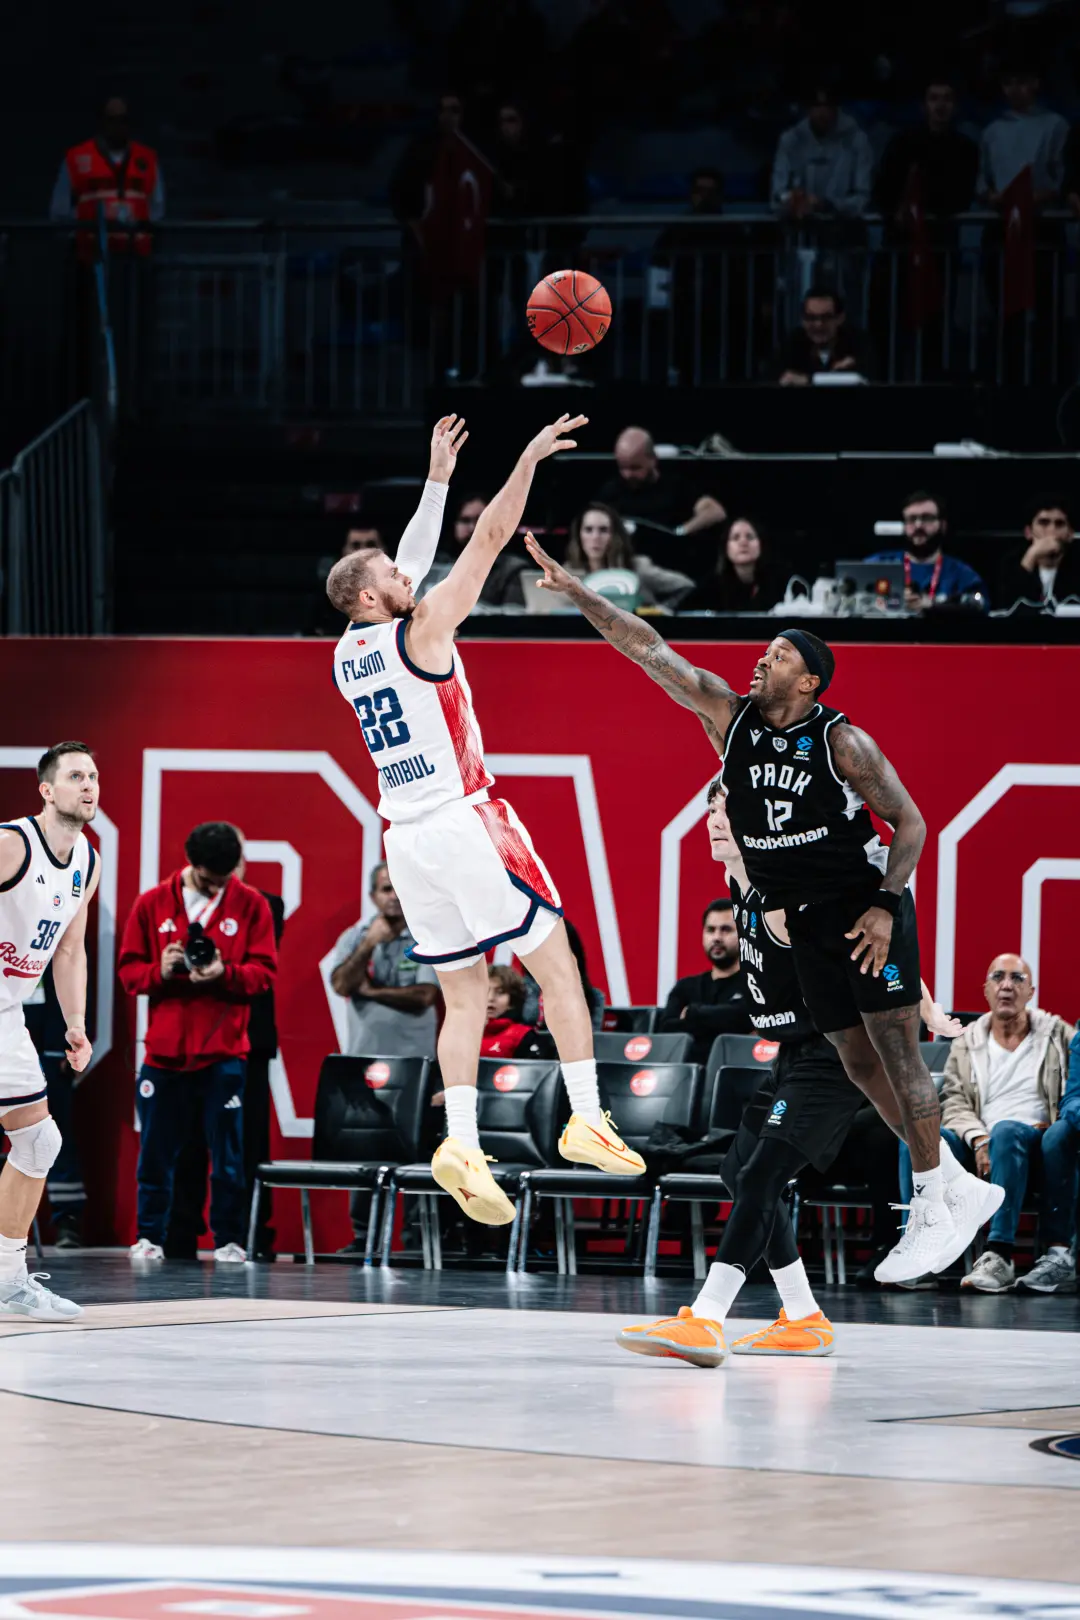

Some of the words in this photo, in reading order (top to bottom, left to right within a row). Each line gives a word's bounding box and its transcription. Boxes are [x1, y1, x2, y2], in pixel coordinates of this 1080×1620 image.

[353, 686, 411, 753] 22
[379, 754, 435, 789] ANBUL
[749, 763, 812, 796] PAOK
[764, 798, 793, 831] 12
[30, 919, 61, 951] 38
[739, 937, 764, 972] PAOK
[747, 972, 766, 1005] 6
[749, 1010, 796, 1029] ximan
